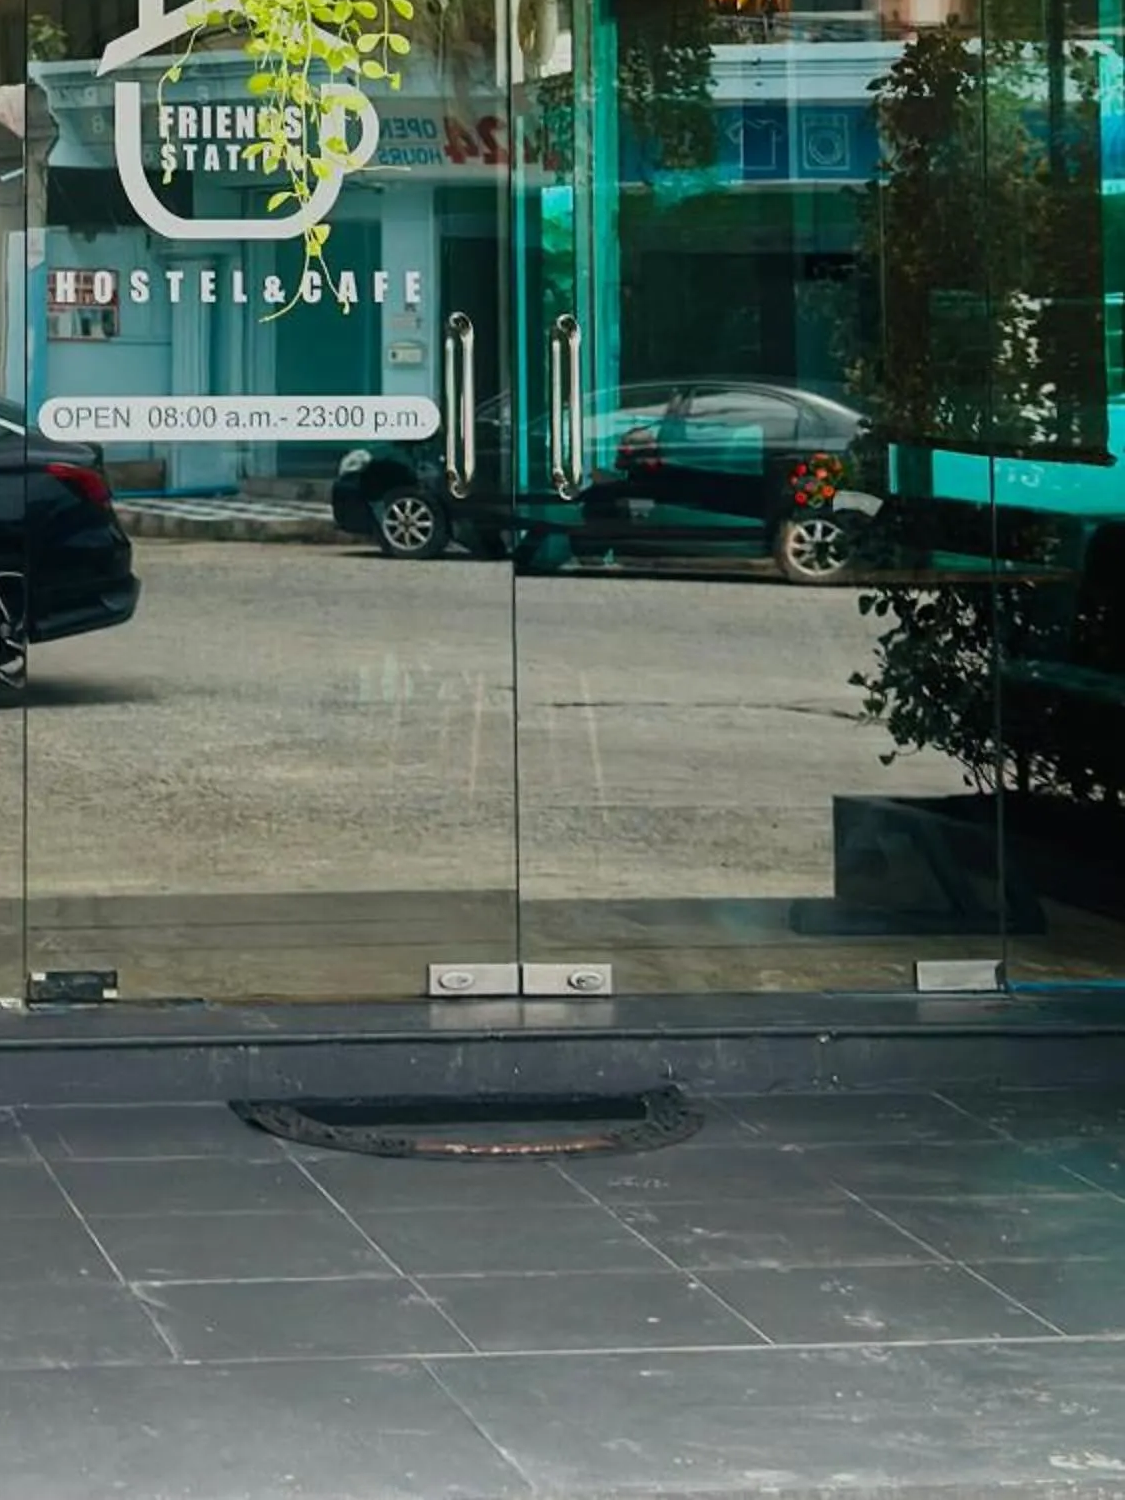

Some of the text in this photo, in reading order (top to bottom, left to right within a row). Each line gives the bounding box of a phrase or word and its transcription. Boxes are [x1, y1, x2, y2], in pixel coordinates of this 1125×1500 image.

[53, 406, 131, 429] OPEN
[147, 406, 217, 429] 08:00
[295, 405, 365, 428] 23:00
[373, 410, 427, 432] p.m.
